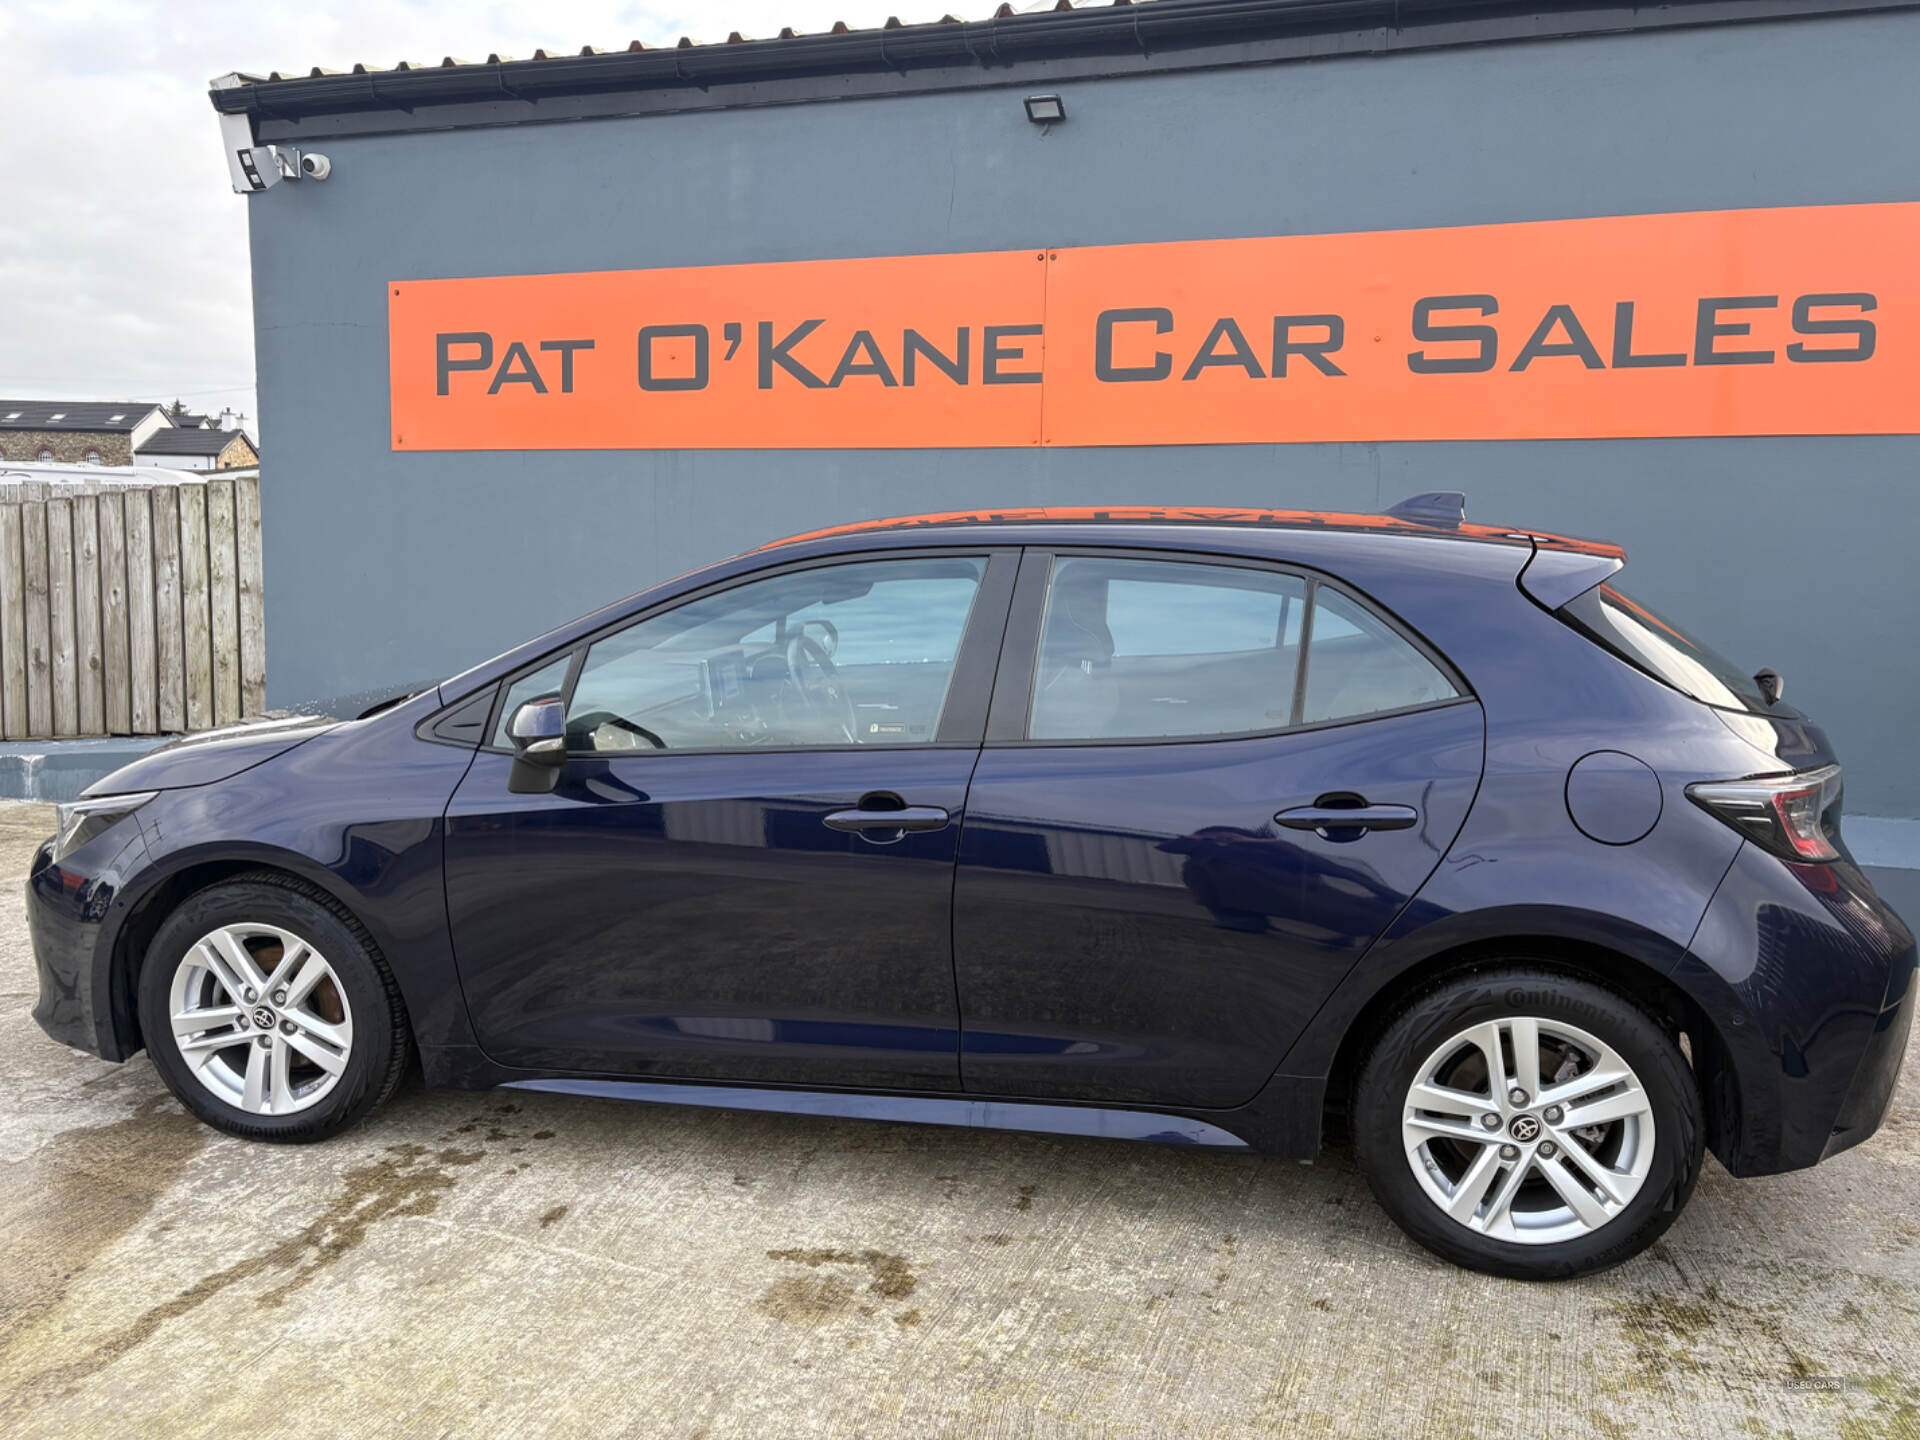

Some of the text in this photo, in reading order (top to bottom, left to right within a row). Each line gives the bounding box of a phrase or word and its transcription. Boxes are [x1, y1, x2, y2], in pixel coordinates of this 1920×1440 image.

[435, 331, 596, 398] PAT
[1093, 305, 1348, 385] CAR
[1405, 291, 1879, 377] SALES
